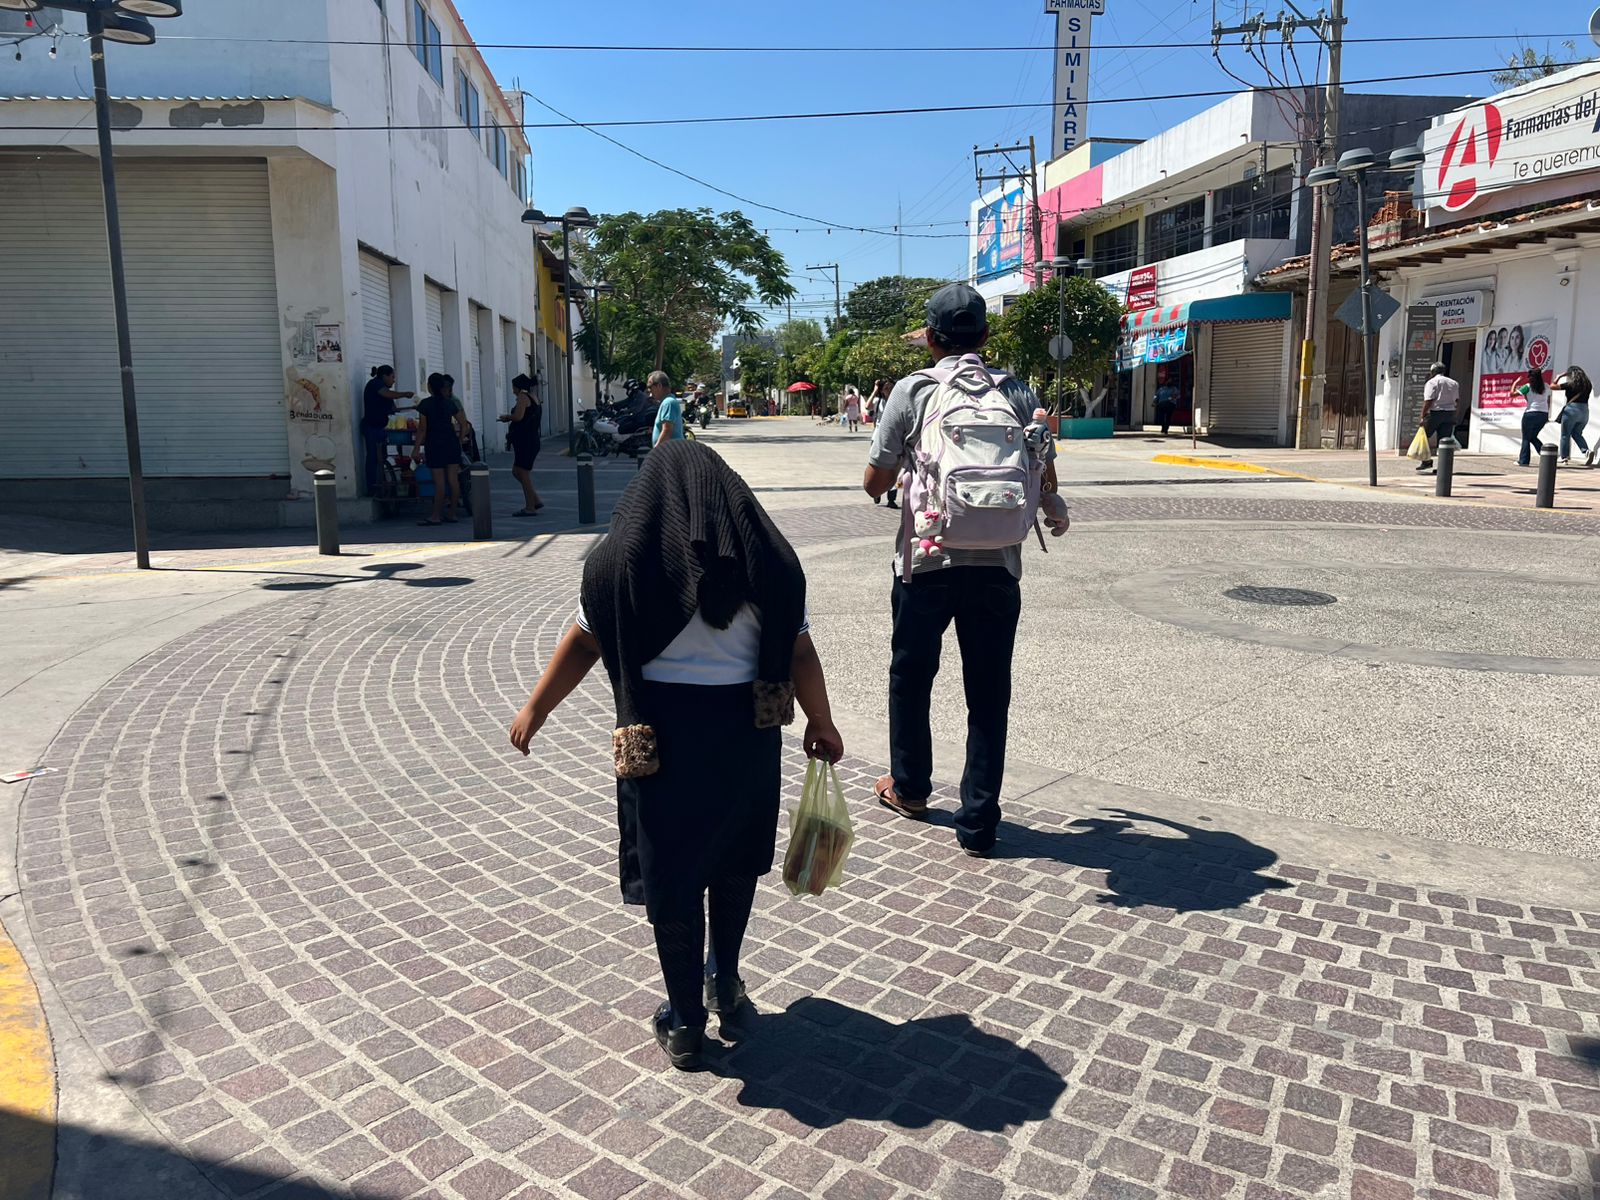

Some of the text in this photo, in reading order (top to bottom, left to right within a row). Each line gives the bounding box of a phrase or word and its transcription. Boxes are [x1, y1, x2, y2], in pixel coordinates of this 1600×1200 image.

[1050, 0, 1101, 9] FARMACIAS
[1506, 105, 1571, 140] Farmacias
[1575, 92, 1597, 120] del
[1513, 162, 1529, 178] Te
[1435, 295, 1475, 308] ORIENTACIÓN
[1442, 308, 1465, 317] MÉDICA
